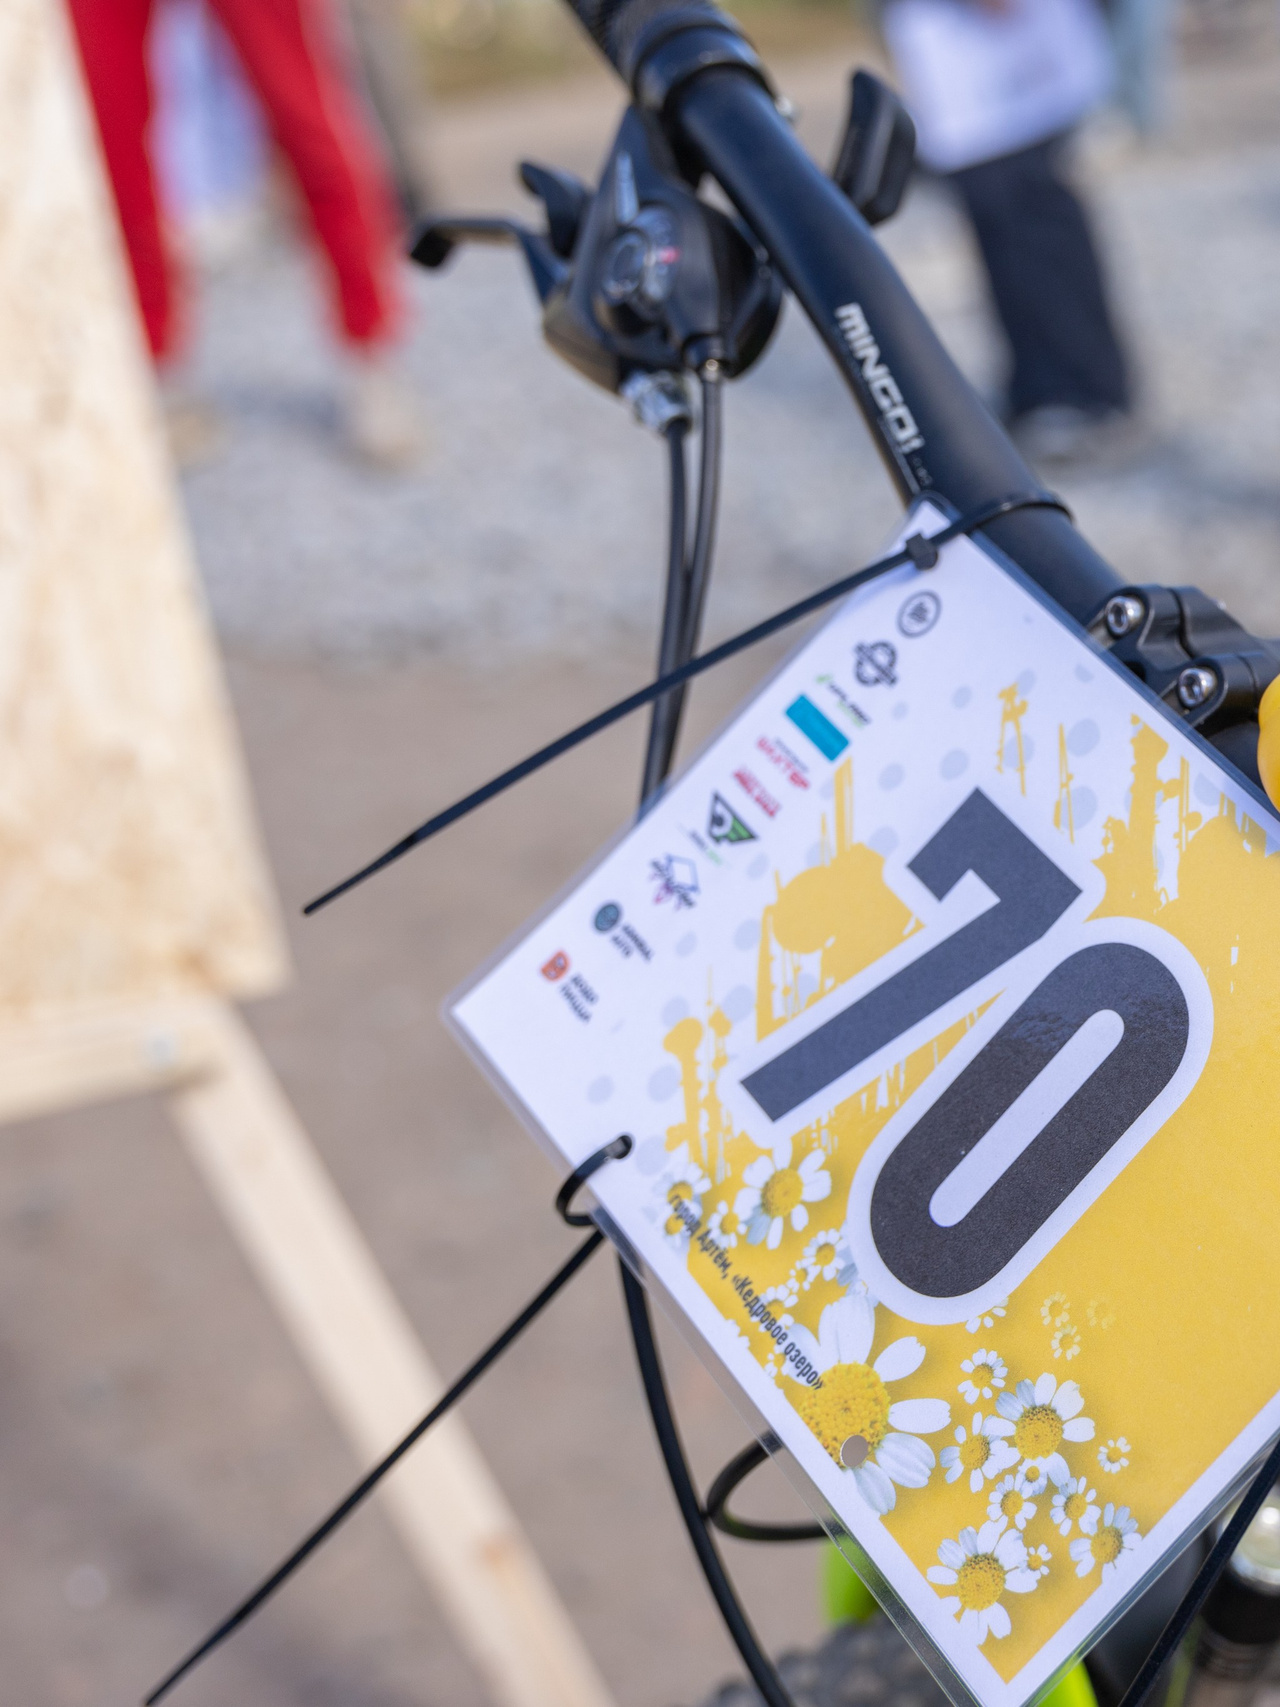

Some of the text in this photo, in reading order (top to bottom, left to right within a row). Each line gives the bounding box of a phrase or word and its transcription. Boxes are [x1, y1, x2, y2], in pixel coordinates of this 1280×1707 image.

[740, 786, 1190, 1298] 70
[669, 1194, 823, 1390] город Артём, «Кедровое озеро»
